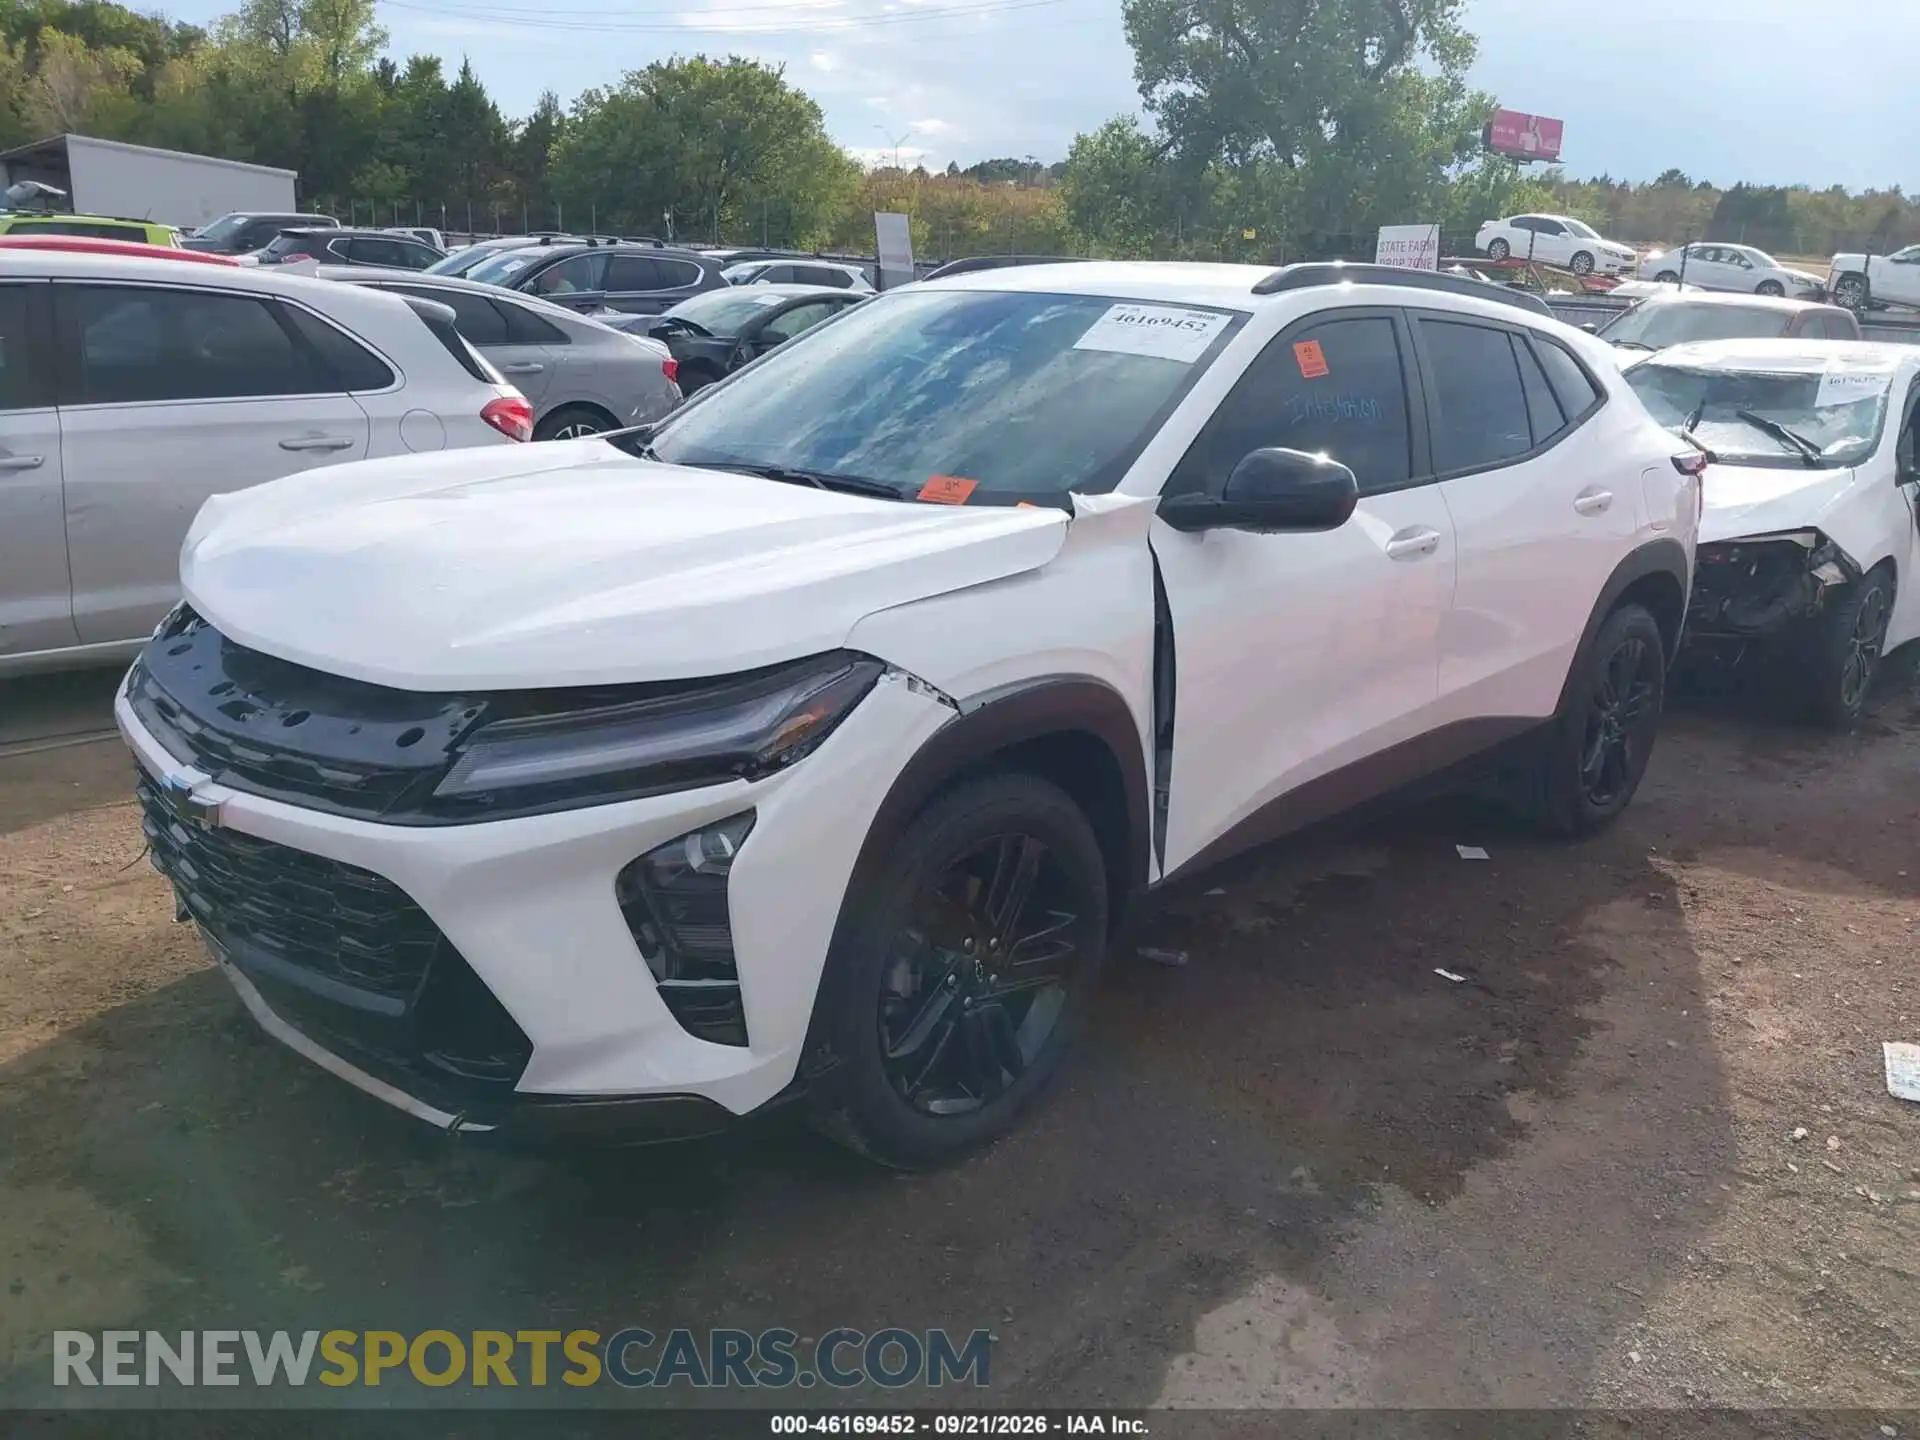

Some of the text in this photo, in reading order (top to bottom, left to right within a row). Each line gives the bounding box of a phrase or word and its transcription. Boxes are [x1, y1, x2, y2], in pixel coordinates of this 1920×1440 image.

[1379, 239, 1436, 253] STATE FARM
[1408, 257, 1433, 270] ZONE
[1112, 312, 1208, 332] 46169452
